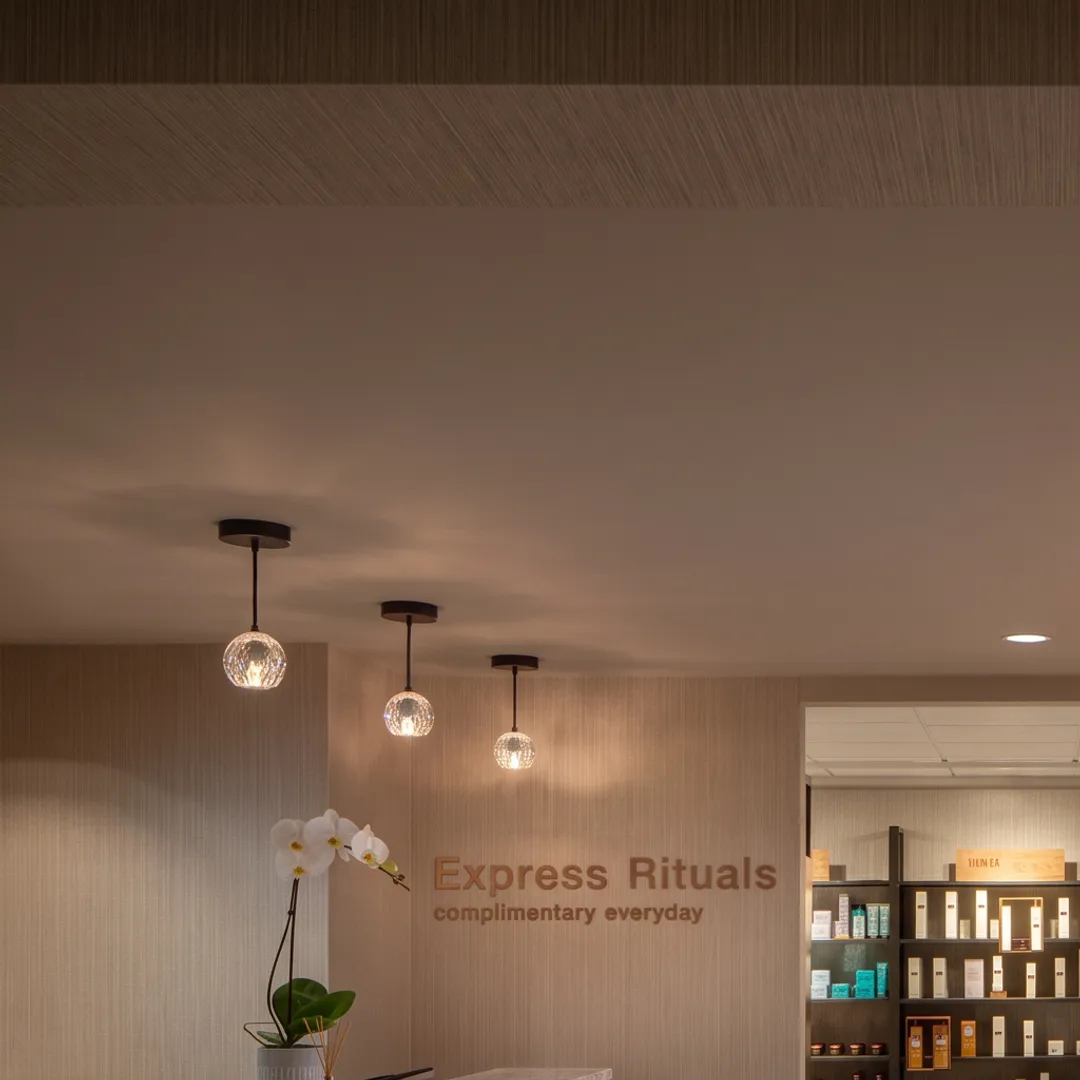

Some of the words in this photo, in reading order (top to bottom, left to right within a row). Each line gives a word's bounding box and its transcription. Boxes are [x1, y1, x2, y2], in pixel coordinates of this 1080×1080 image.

[434, 856, 609, 897] Express
[628, 856, 777, 891] Rituals
[433, 903, 597, 926] complimentary
[604, 903, 705, 926] everyday
